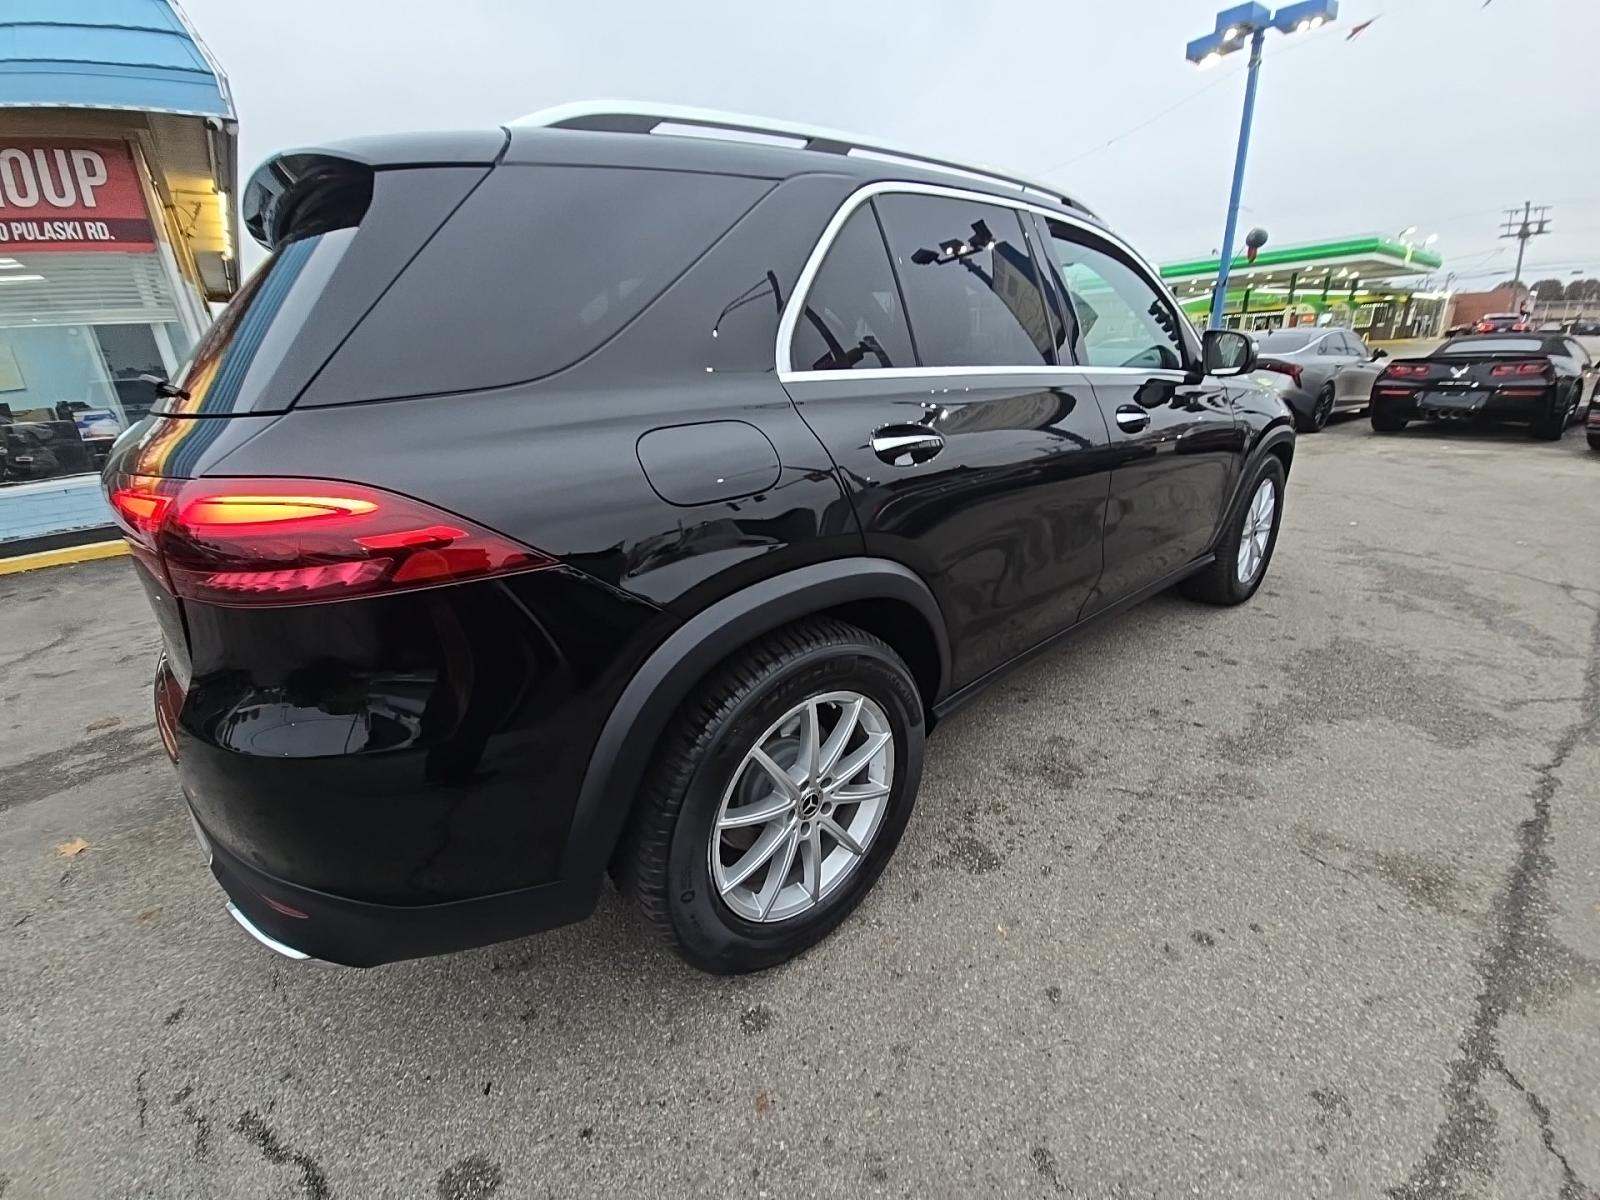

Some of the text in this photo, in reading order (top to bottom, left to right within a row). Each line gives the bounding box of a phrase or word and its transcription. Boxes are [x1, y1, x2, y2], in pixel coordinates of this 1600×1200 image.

[0, 148, 107, 207] OUP
[10, 222, 84, 241] PULASKI
[84, 222, 116, 240] RD.
